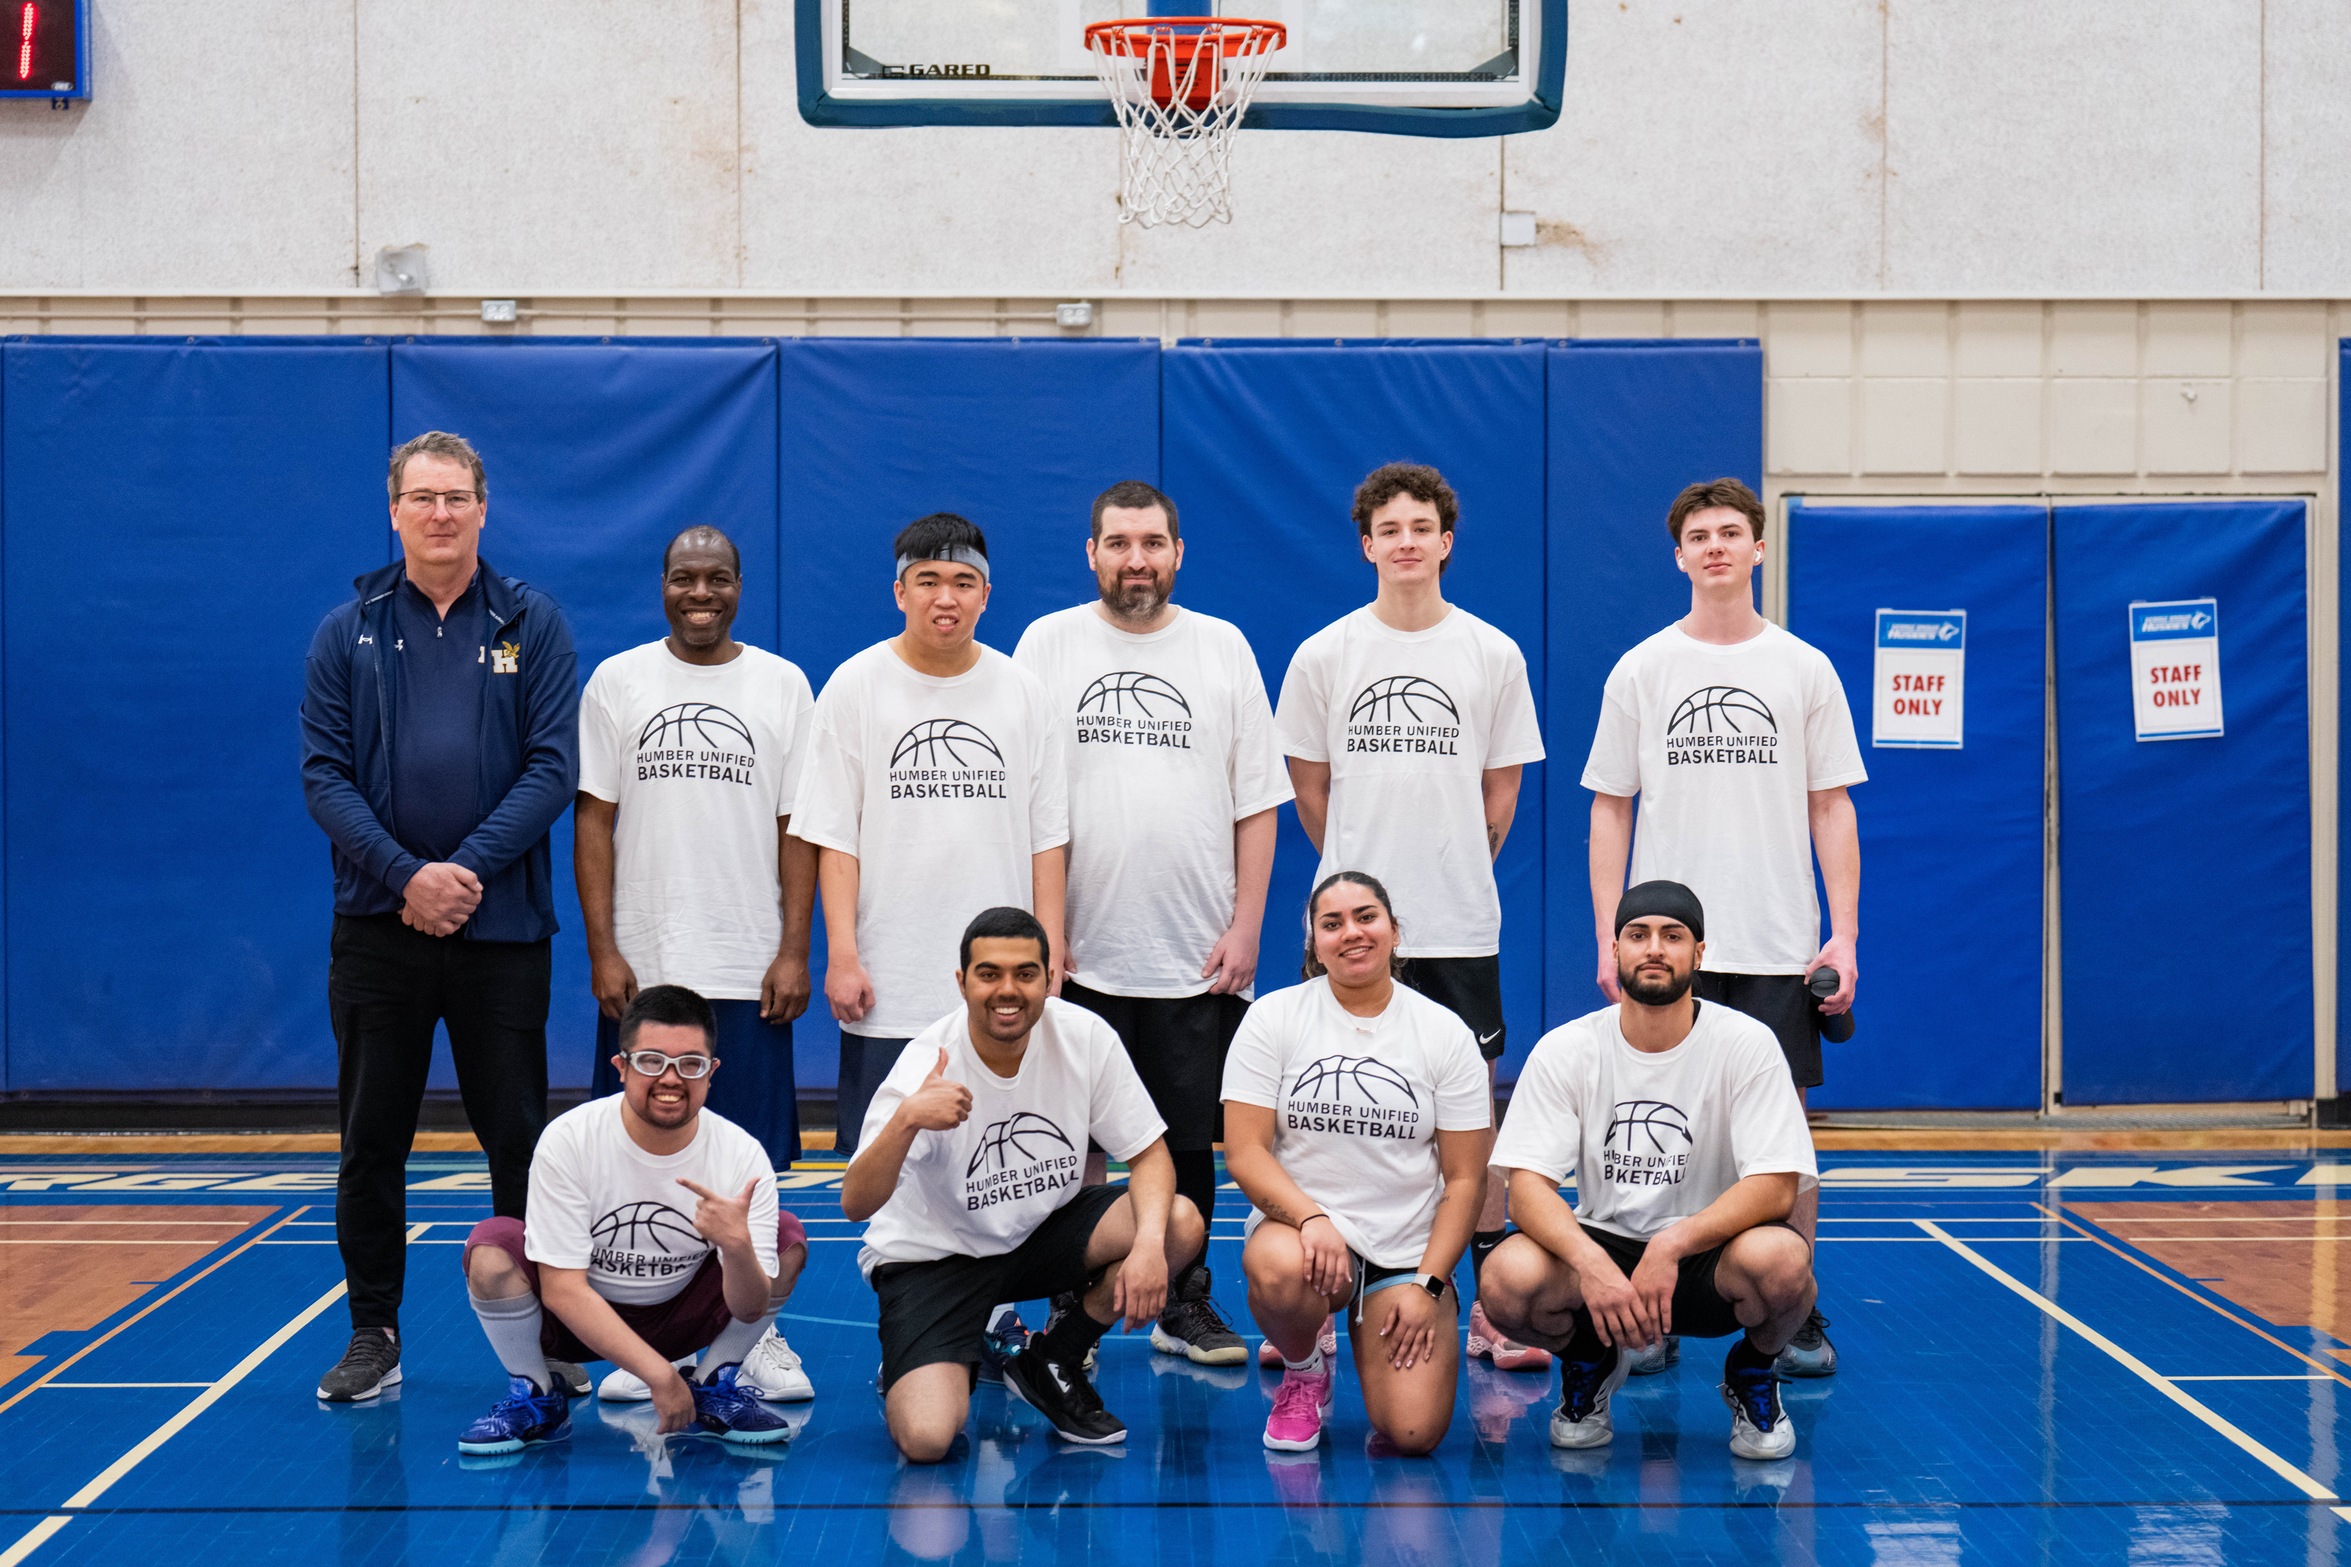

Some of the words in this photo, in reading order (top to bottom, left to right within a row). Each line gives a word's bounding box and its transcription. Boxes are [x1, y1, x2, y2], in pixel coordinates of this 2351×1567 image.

[909, 63, 991, 76] GARED
[1893, 674, 1945, 692] STAFF
[2150, 664, 2202, 684] STAFF
[1894, 698, 1943, 715] ONLY
[2153, 688, 2201, 707] ONLY
[1076, 715, 1132, 730] HUMBER
[1137, 720, 1192, 732] UNIFIED
[1347, 725, 1402, 737] HUMBER
[1407, 726, 1461, 738] UNIFIED
[1077, 729, 1192, 750] BASKETBALL
[1347, 738, 1459, 756] BASKETBALL
[1667, 736, 1723, 748] HUMBER
[1726, 735, 1778, 748] UNIFIED
[636, 750, 695, 763] HUMBER
[700, 751, 755, 768] UNIFIED
[1667, 749, 1779, 766] BASKETBALL
[637, 764, 753, 786] BASKETBALL
[890, 770, 947, 782] HUMBER
[952, 770, 1006, 781] UNIFIED
[891, 783, 1007, 799] BASKETBALL
[1287, 1100, 1352, 1117] HUMBER
[1360, 1106, 1419, 1123] UNIFIED
[1287, 1113, 1417, 1140] BASKETBALL
[966, 1169, 1018, 1193] HUMBER
[1024, 1155, 1078, 1179] UNIFIED
[967, 1169, 1079, 1211] BASKETBALL
